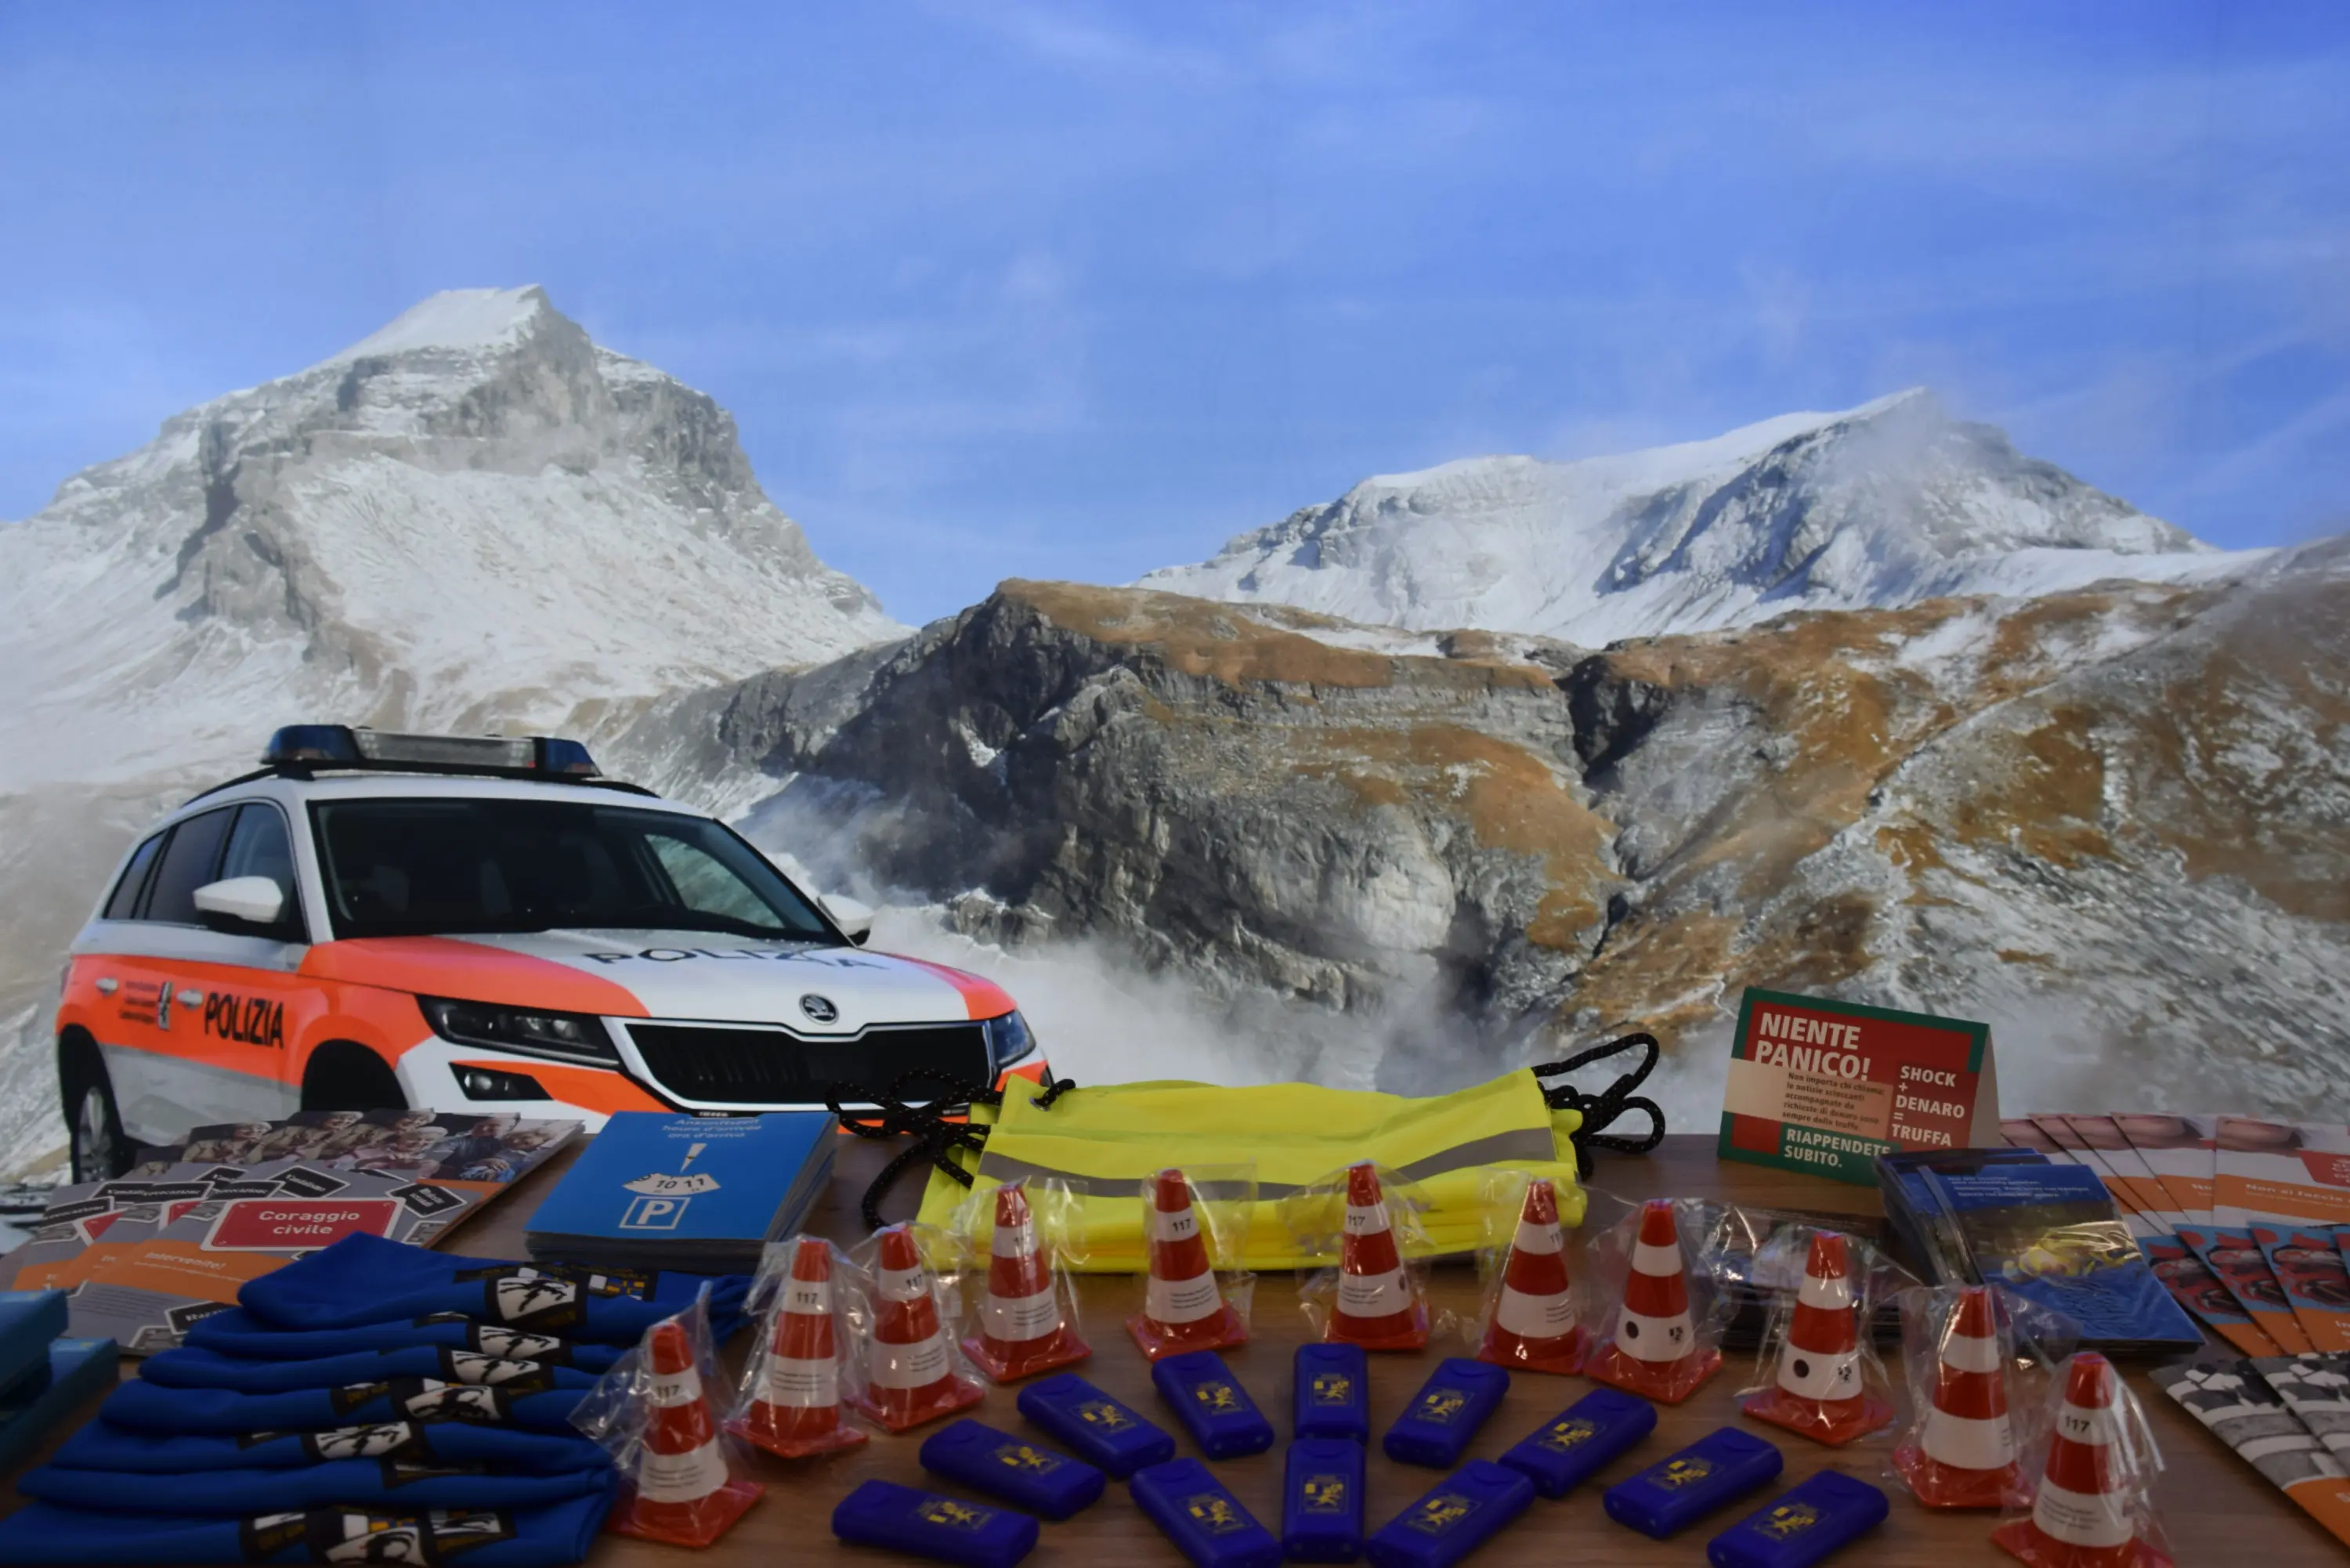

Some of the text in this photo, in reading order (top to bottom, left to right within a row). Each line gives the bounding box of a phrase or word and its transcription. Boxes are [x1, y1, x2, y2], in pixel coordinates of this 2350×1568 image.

[584, 948, 891, 970] POLIZIA
[205, 992, 284, 1050] POLIZIA
[1759, 1012, 1861, 1050] NIENTE
[1755, 1040, 1871, 1081] PANICO!
[1788, 1073, 1804, 1082] Non
[1806, 1075, 1838, 1088] importa
[1900, 1065, 1957, 1087] SHOCK
[1796, 1083, 1824, 1094] notizie
[1785, 1092, 1854, 1110] accompagnate da
[1896, 1095, 1965, 1118] DENARO
[1783, 1111, 1811, 1122] sempre
[1784, 1101, 1817, 1114] richieste
[1830, 1109, 1857, 1120] denaro
[1786, 1128, 1891, 1157] RIAPPENDETE
[1892, 1123, 1952, 1147] TRUFFA
[1784, 1145, 1842, 1168] SUBITO.
[656, 1178, 704, 1189] 10 11
[2245, 1183, 2276, 1193] Non
[258, 1210, 360, 1223] Coraggio
[636, 1200, 674, 1224] P
[273, 1224, 333, 1235] civile
[1172, 1218, 1191, 1231] 117
[1347, 1215, 1365, 1227] 117
[796, 1292, 818, 1304] 117
[656, 1385, 680, 1398] 117
[2065, 1415, 2090, 1432] 117
